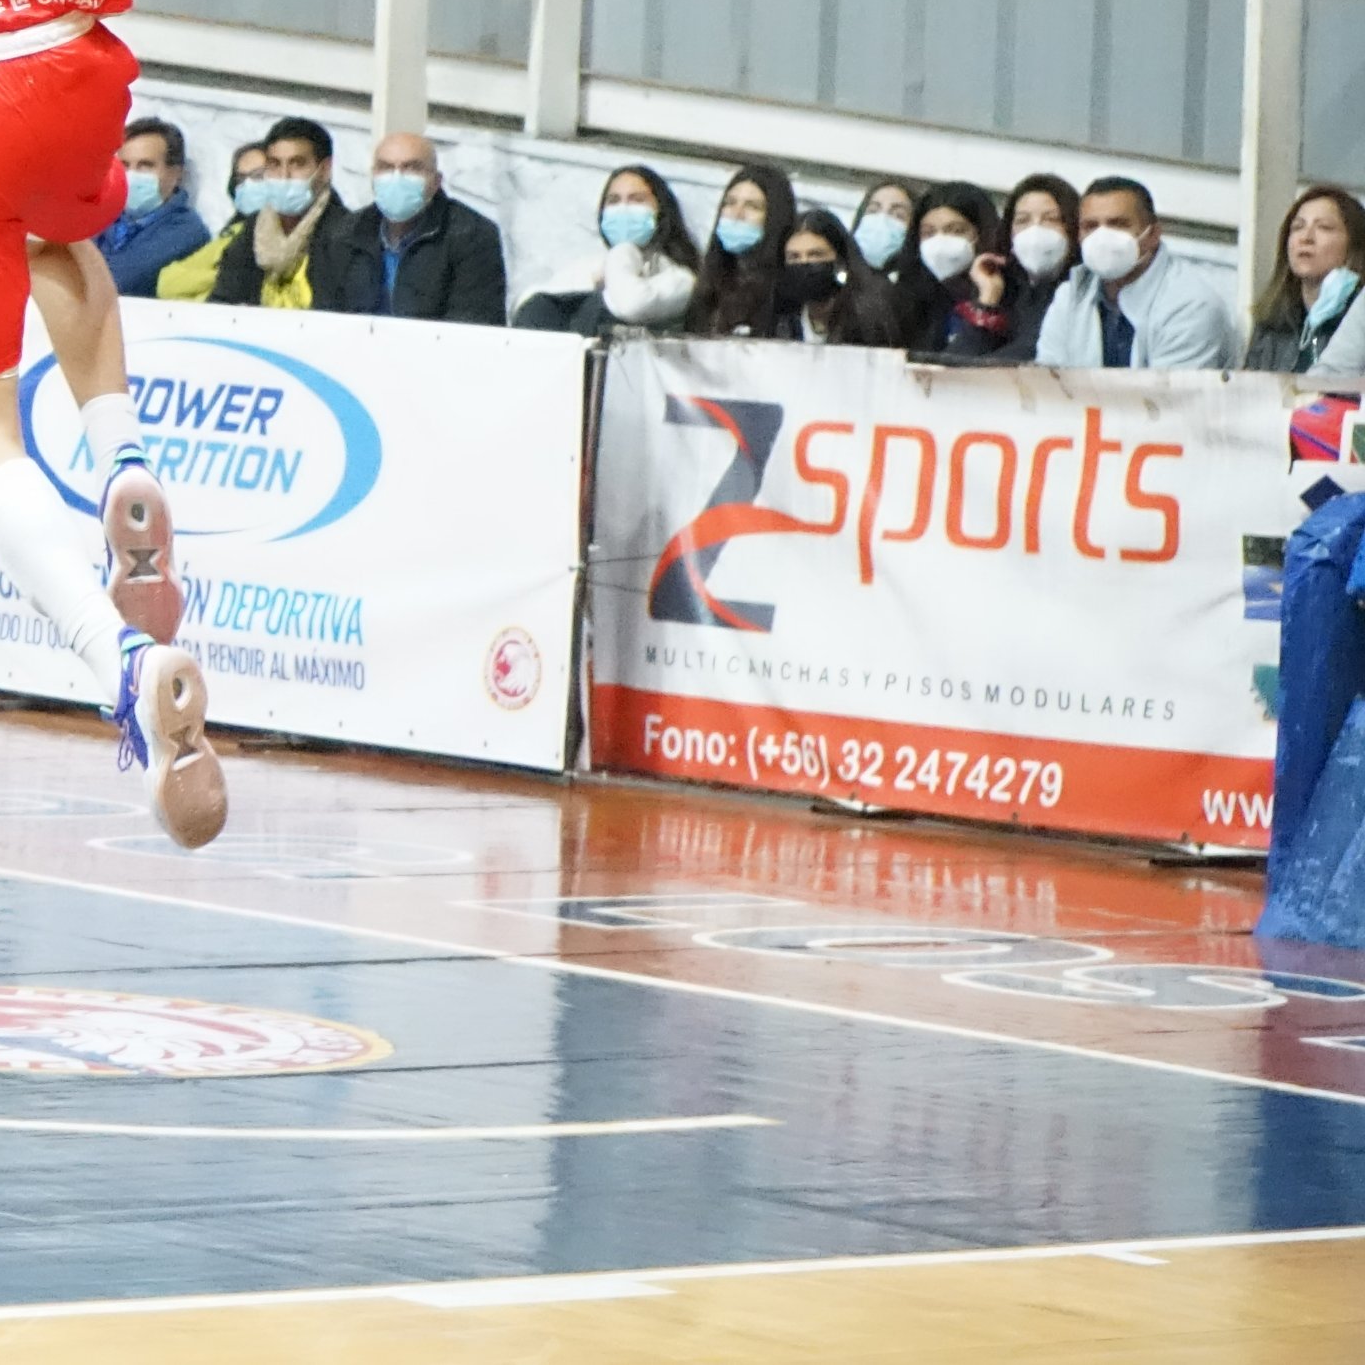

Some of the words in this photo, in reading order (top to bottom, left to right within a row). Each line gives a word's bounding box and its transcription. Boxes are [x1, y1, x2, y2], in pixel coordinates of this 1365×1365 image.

[68, 426, 303, 495] NTRITION
[24, 617, 43, 644] LO
[213, 581, 365, 647] DEPORTIVA
[206, 640, 266, 679] RENDIR
[269, 653, 291, 681] AL
[293, 646, 366, 691] MÁXIMO
[884, 672, 973, 701] PISOS
[983, 683, 1177, 722] MODULARES
[643, 712, 738, 768] Fono:
[746, 725, 832, 791] (+56)
[836, 738, 886, 788] 32
[892, 744, 1065, 809] 2474279
